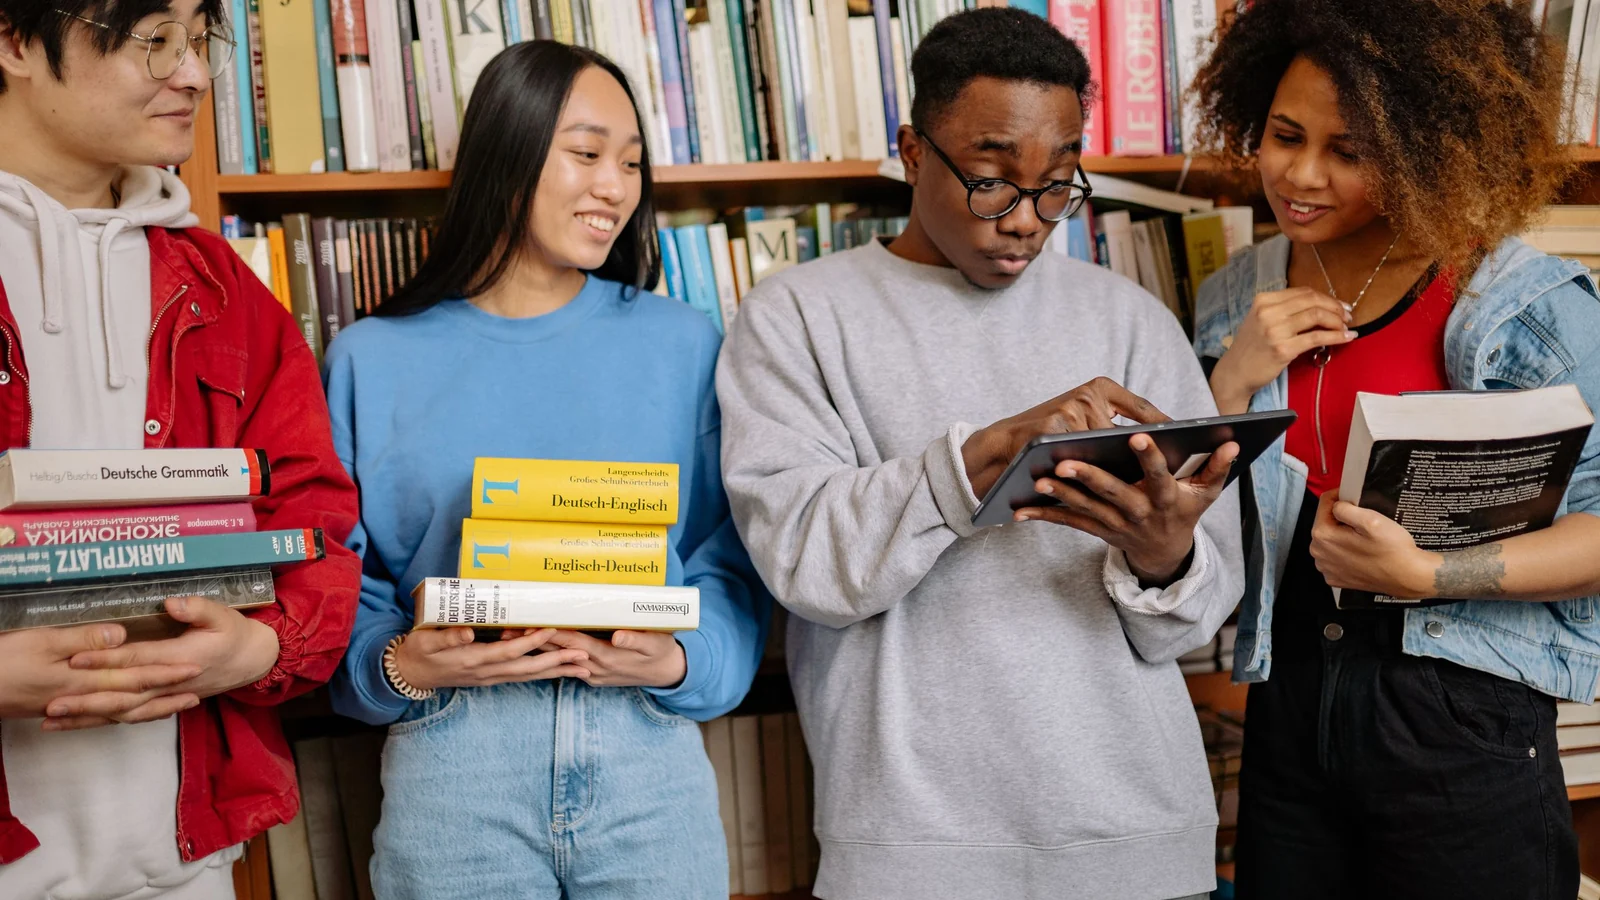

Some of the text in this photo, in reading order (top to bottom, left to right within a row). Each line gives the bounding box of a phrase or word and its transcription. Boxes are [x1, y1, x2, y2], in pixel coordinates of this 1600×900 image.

[1127, 110, 1156, 150] LE
[756, 230, 790, 261] M
[101, 466, 158, 480] Deutsche
[161, 465, 229, 479] Grammatik
[569, 476, 669, 487] Großes Schulwörterbuch
[607, 467, 669, 478] Langenscheidts
[552, 494, 668, 514] Deutsch-Englisch
[24, 524, 180, 546] ЭКОНОМИКА
[598, 530, 660, 538] Langenscheidts
[56, 542, 185, 573] MARKTPLATZ
[543, 557, 659, 574] Englisch-Deutsch
[26, 606, 58, 614] MEMORIA
[438, 596, 446, 610] neue
[448, 580, 460, 622] DEUTSCHE
[462, 584, 475, 623] WÖRTER-
[436, 612, 446, 622] Das
[477, 600, 487, 623] BUCH
